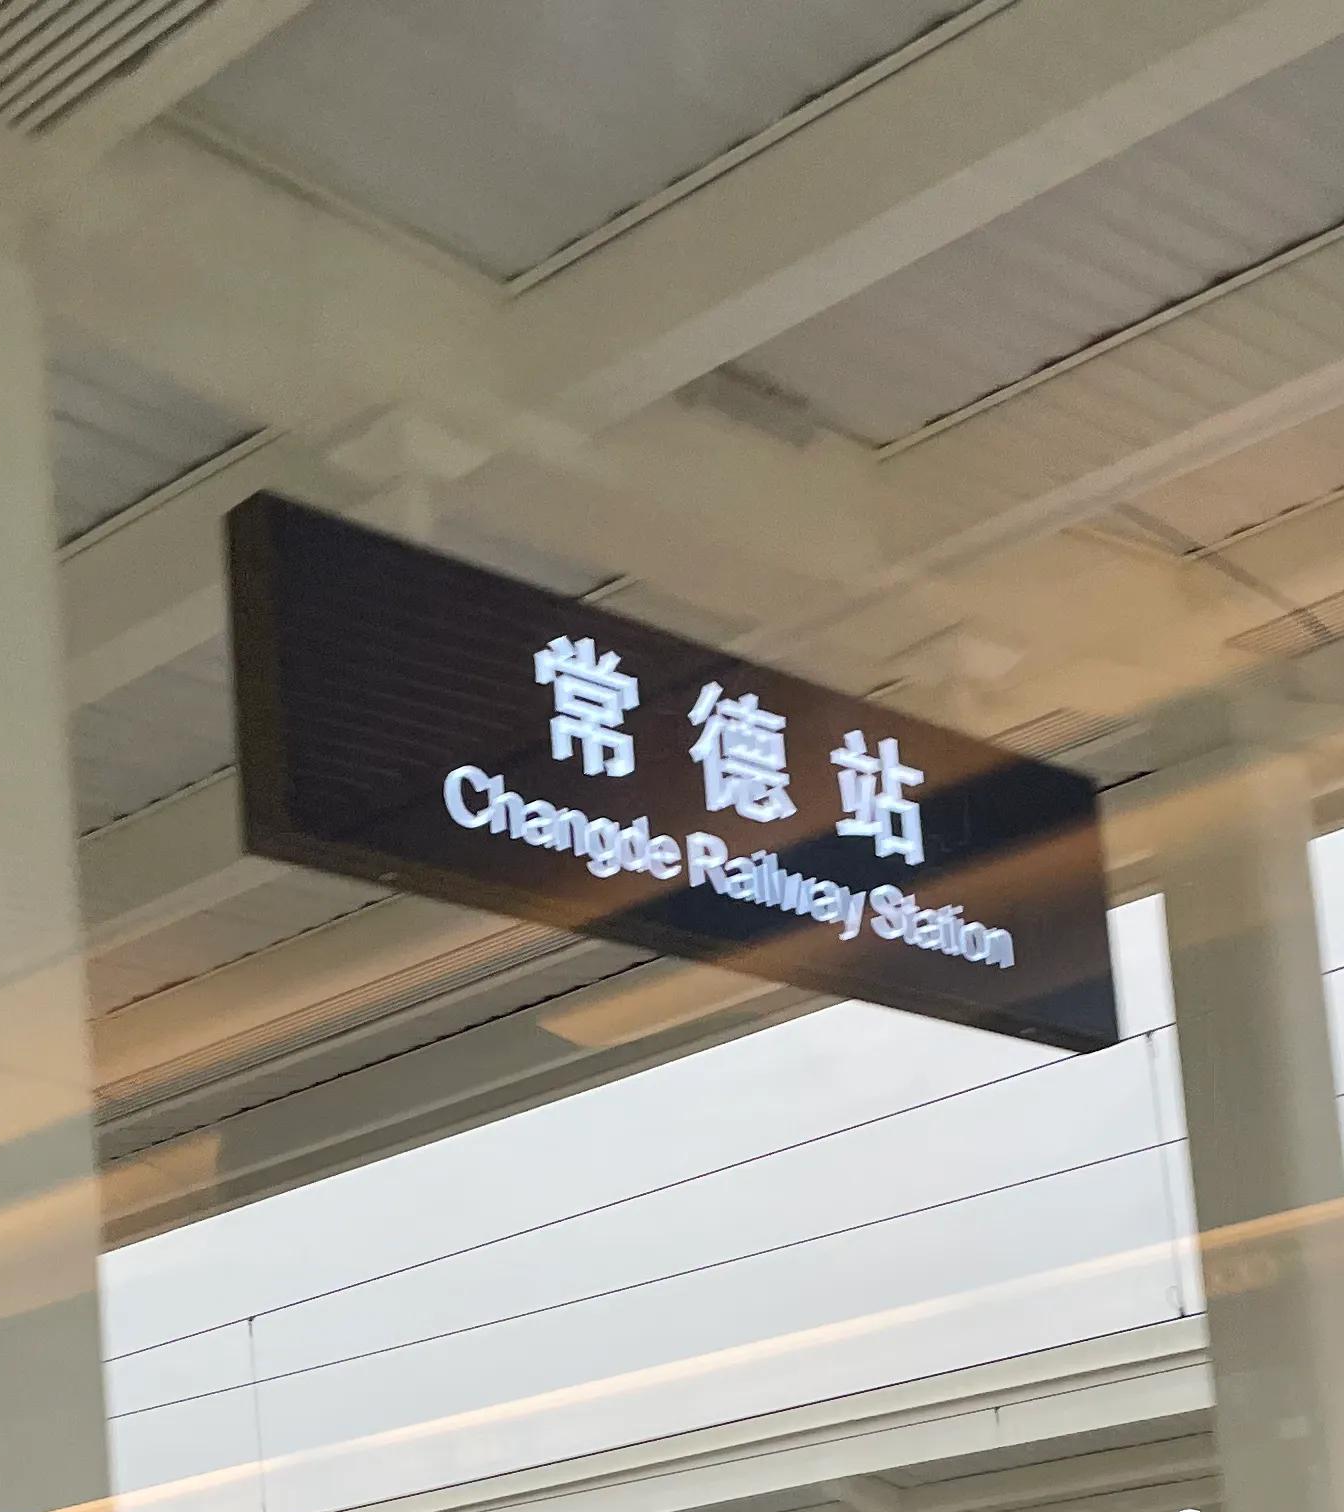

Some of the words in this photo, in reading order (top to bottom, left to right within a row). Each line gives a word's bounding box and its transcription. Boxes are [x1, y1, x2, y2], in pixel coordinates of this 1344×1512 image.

[533, 635, 925, 866] 常德站
[443, 765, 682, 880] Changde
[685, 831, 867, 941] Railway
[869, 883, 1015, 969] Station
